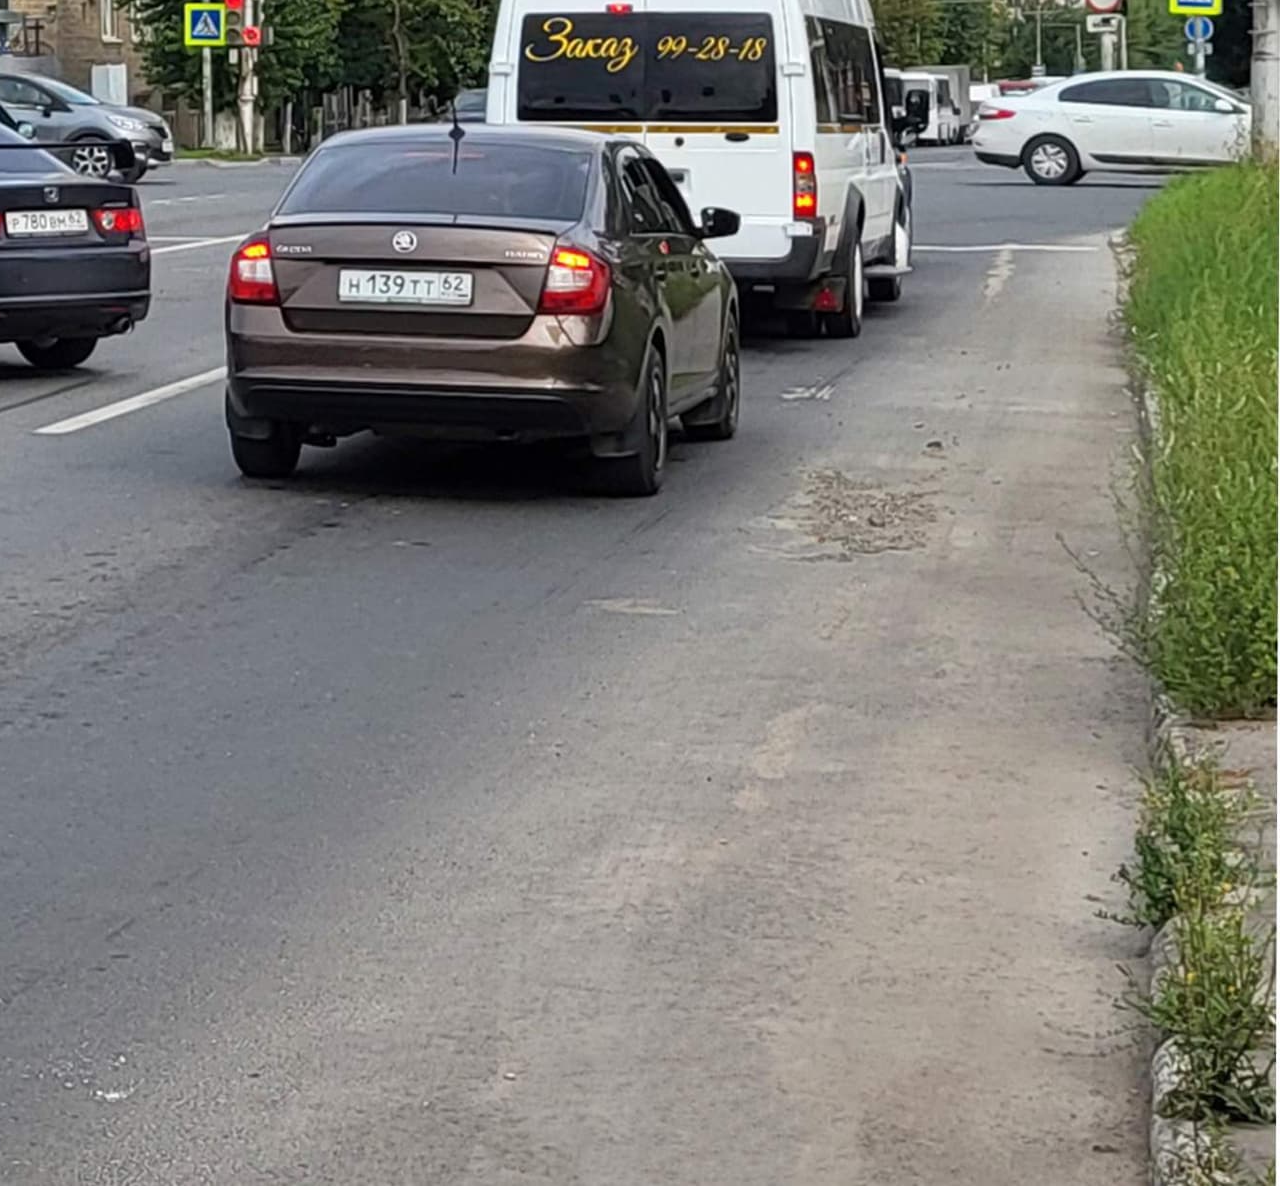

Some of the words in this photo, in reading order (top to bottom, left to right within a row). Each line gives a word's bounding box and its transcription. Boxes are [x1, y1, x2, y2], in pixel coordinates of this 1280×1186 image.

[525, 17, 638, 72] Заказ
[656, 36, 767, 61] 99-28-18
[348, 274, 435, 295] Н139ТТ
[442, 275, 464, 291] 62
